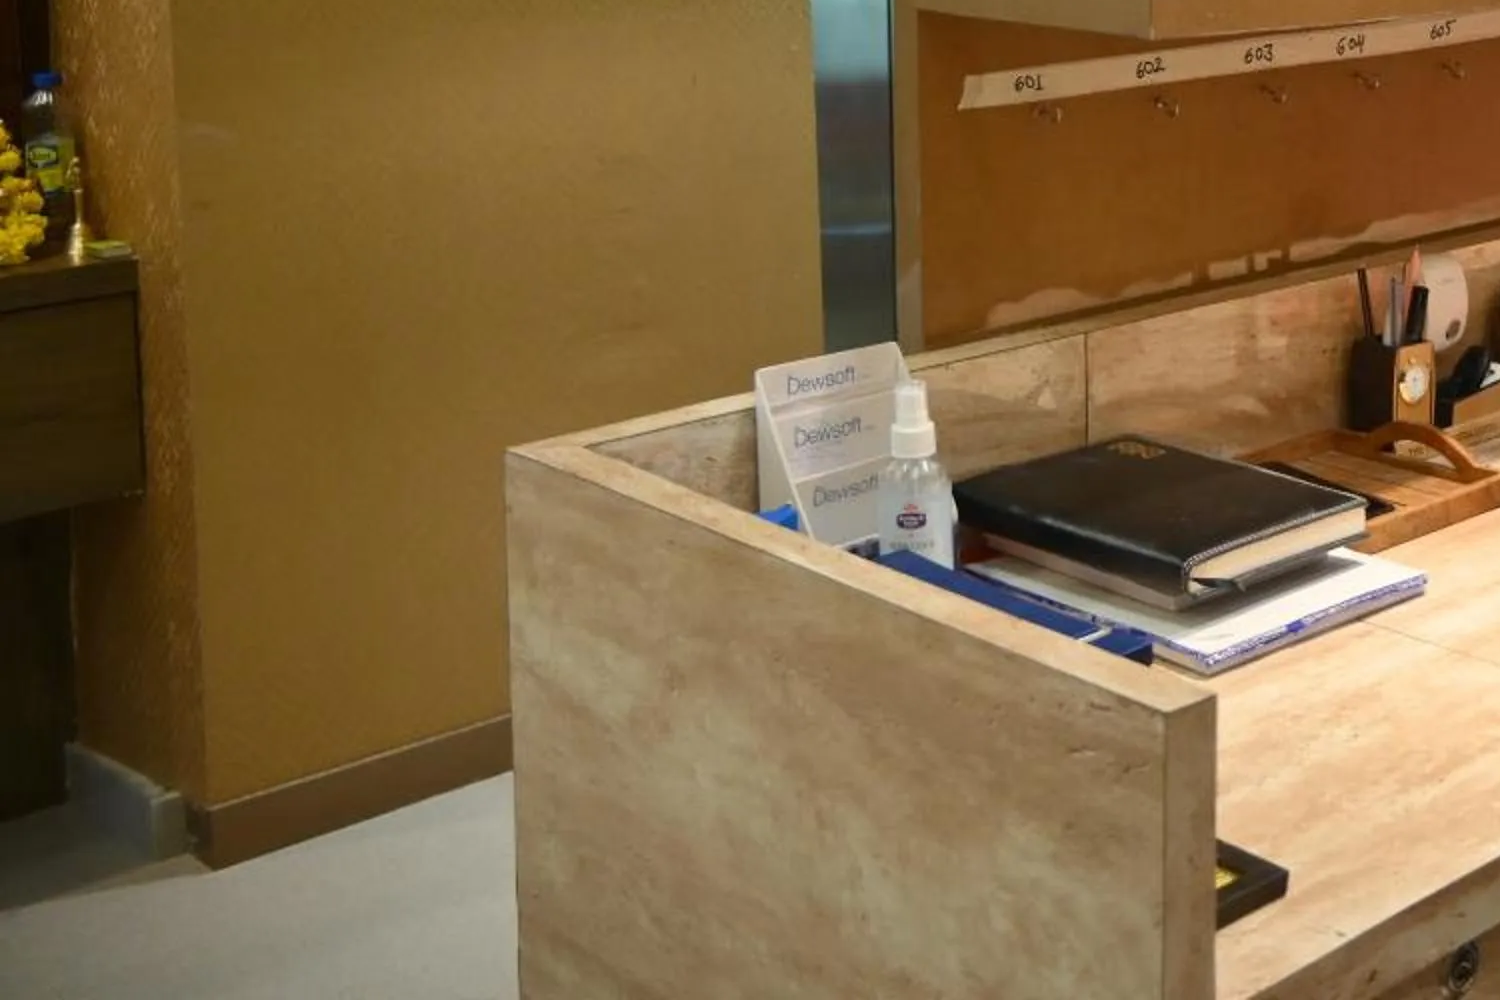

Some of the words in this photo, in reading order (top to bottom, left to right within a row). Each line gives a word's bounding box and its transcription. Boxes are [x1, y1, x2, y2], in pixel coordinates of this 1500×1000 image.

[1014, 74, 1044, 92] 601
[1136, 57, 1166, 79] 602
[1244, 44, 1274, 65] 603
[1335, 34, 1366, 56] 604
[1429, 18, 1457, 40] 605
